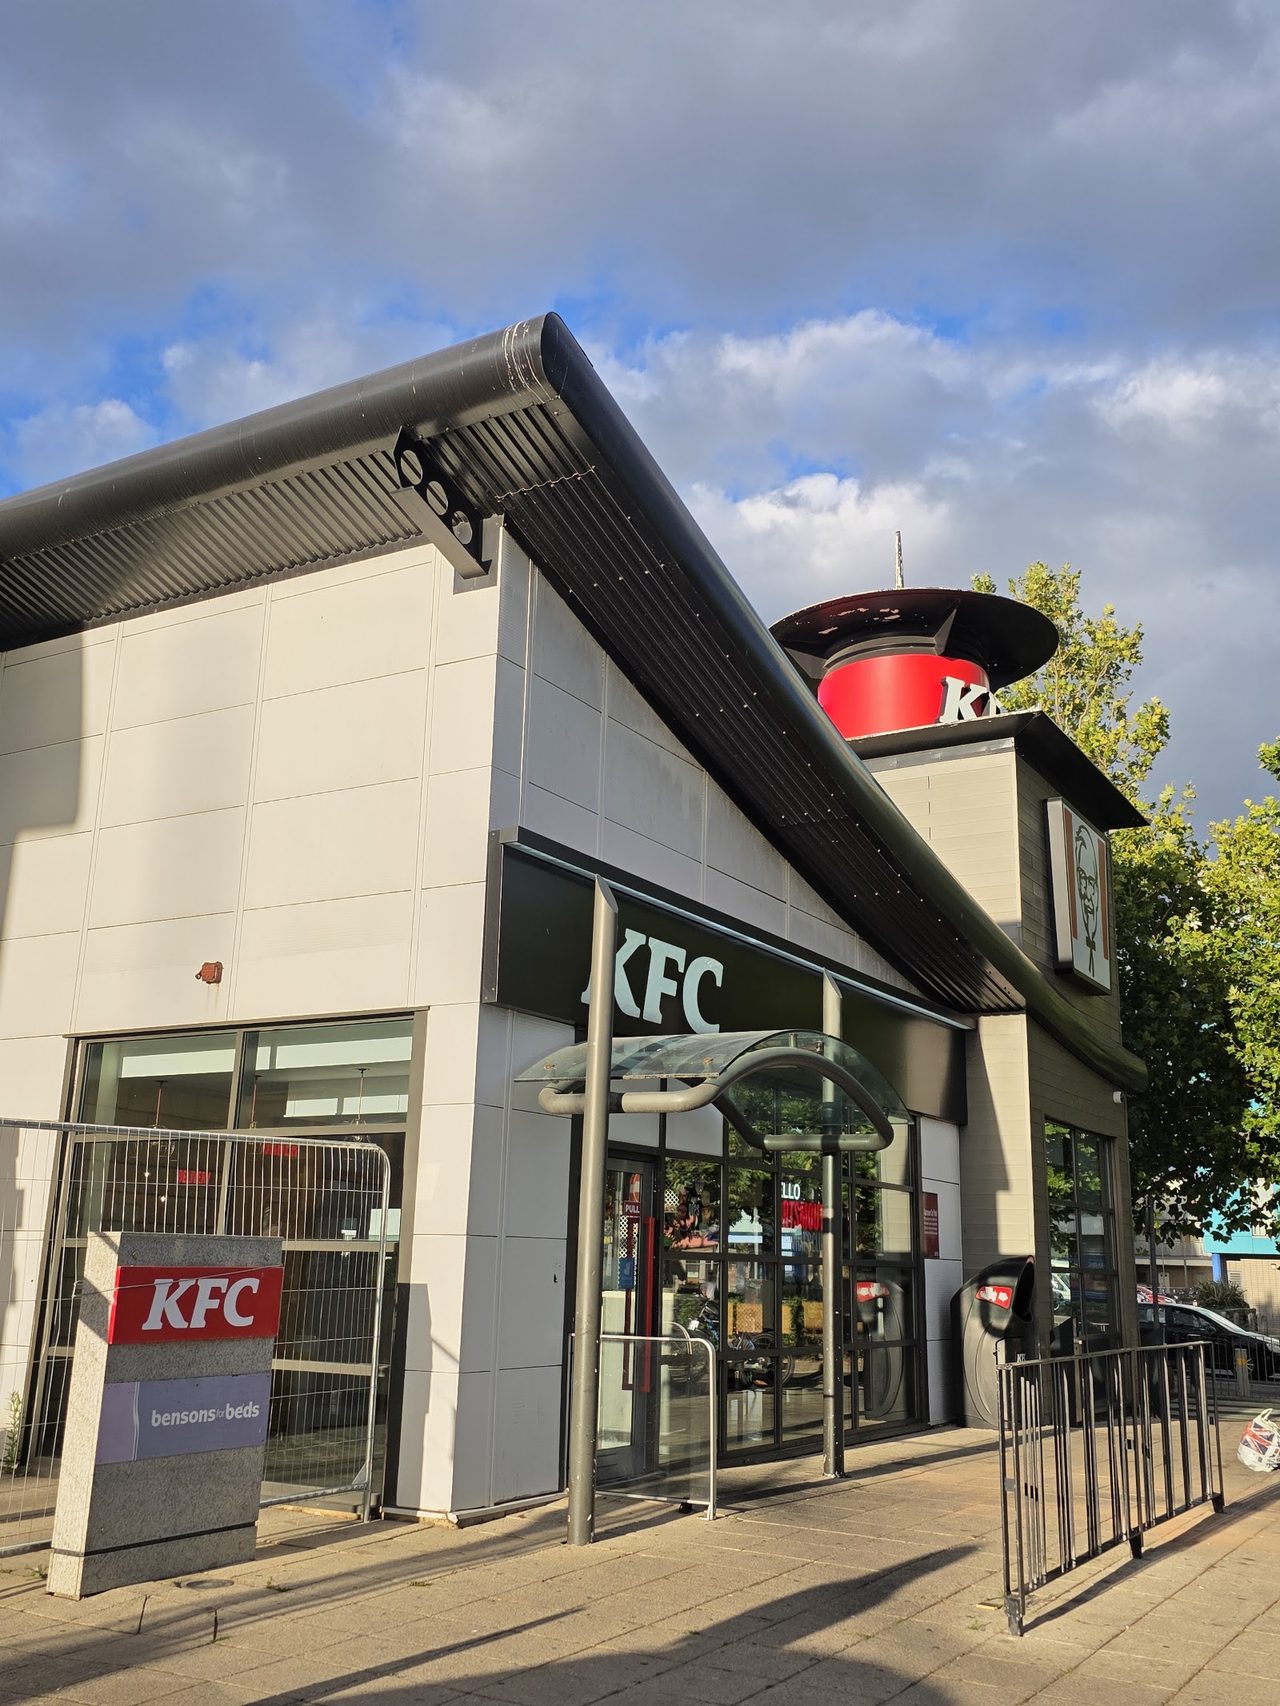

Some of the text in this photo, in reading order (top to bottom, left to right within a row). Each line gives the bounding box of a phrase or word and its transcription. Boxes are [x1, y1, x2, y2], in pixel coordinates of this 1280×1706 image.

[940, 676, 999, 723] K
[625, 1204, 639, 1213] PULL
[142, 1277, 259, 1330] KFC
[151, 1408, 216, 1427] bensons
[225, 1400, 260, 1420] beds
